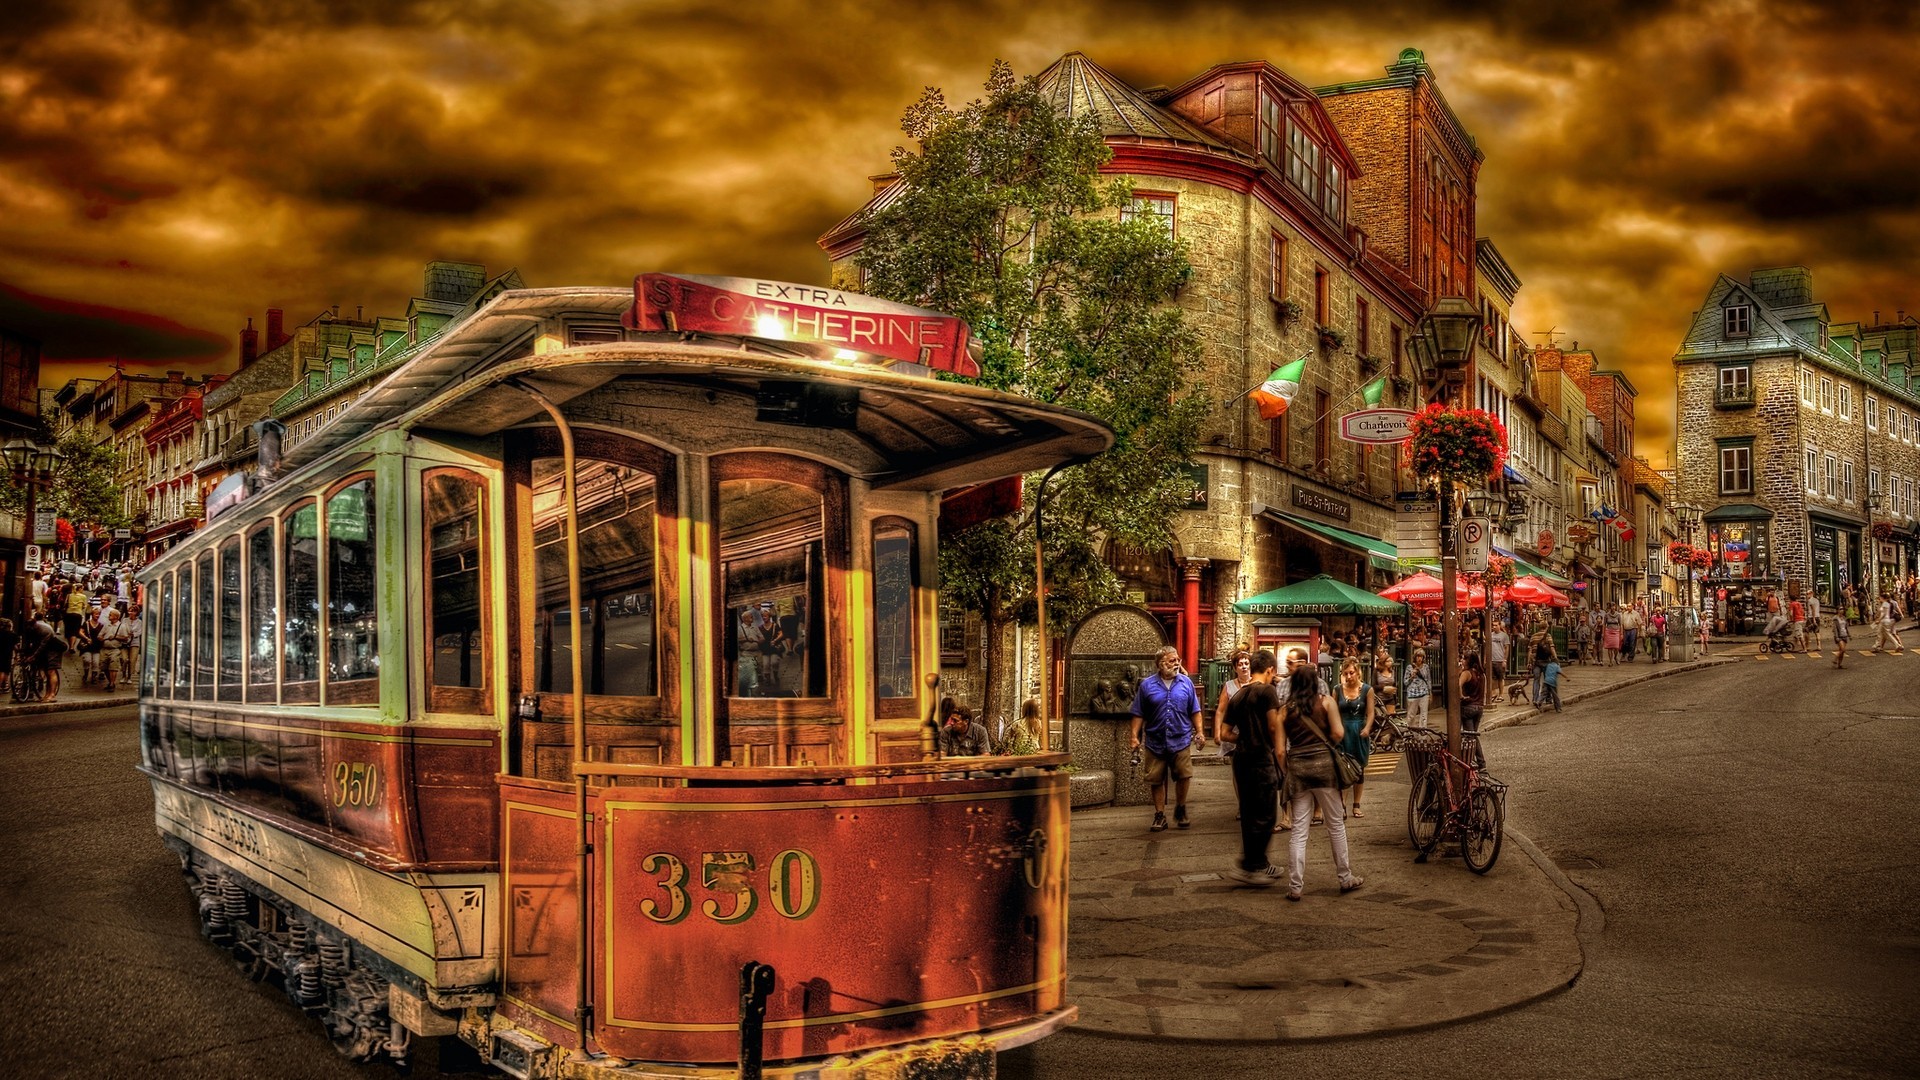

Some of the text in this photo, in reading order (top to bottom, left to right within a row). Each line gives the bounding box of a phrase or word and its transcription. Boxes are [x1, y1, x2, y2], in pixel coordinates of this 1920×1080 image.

[756, 282, 847, 306] EXTRA
[648, 280, 944, 348] ST CATHERINE
[1359, 420, 1408, 430] Charlevoix
[1250, 603, 1338, 613] PUB ST-PATRICK
[331, 761, 377, 807] 350
[640, 849, 819, 923] 350
